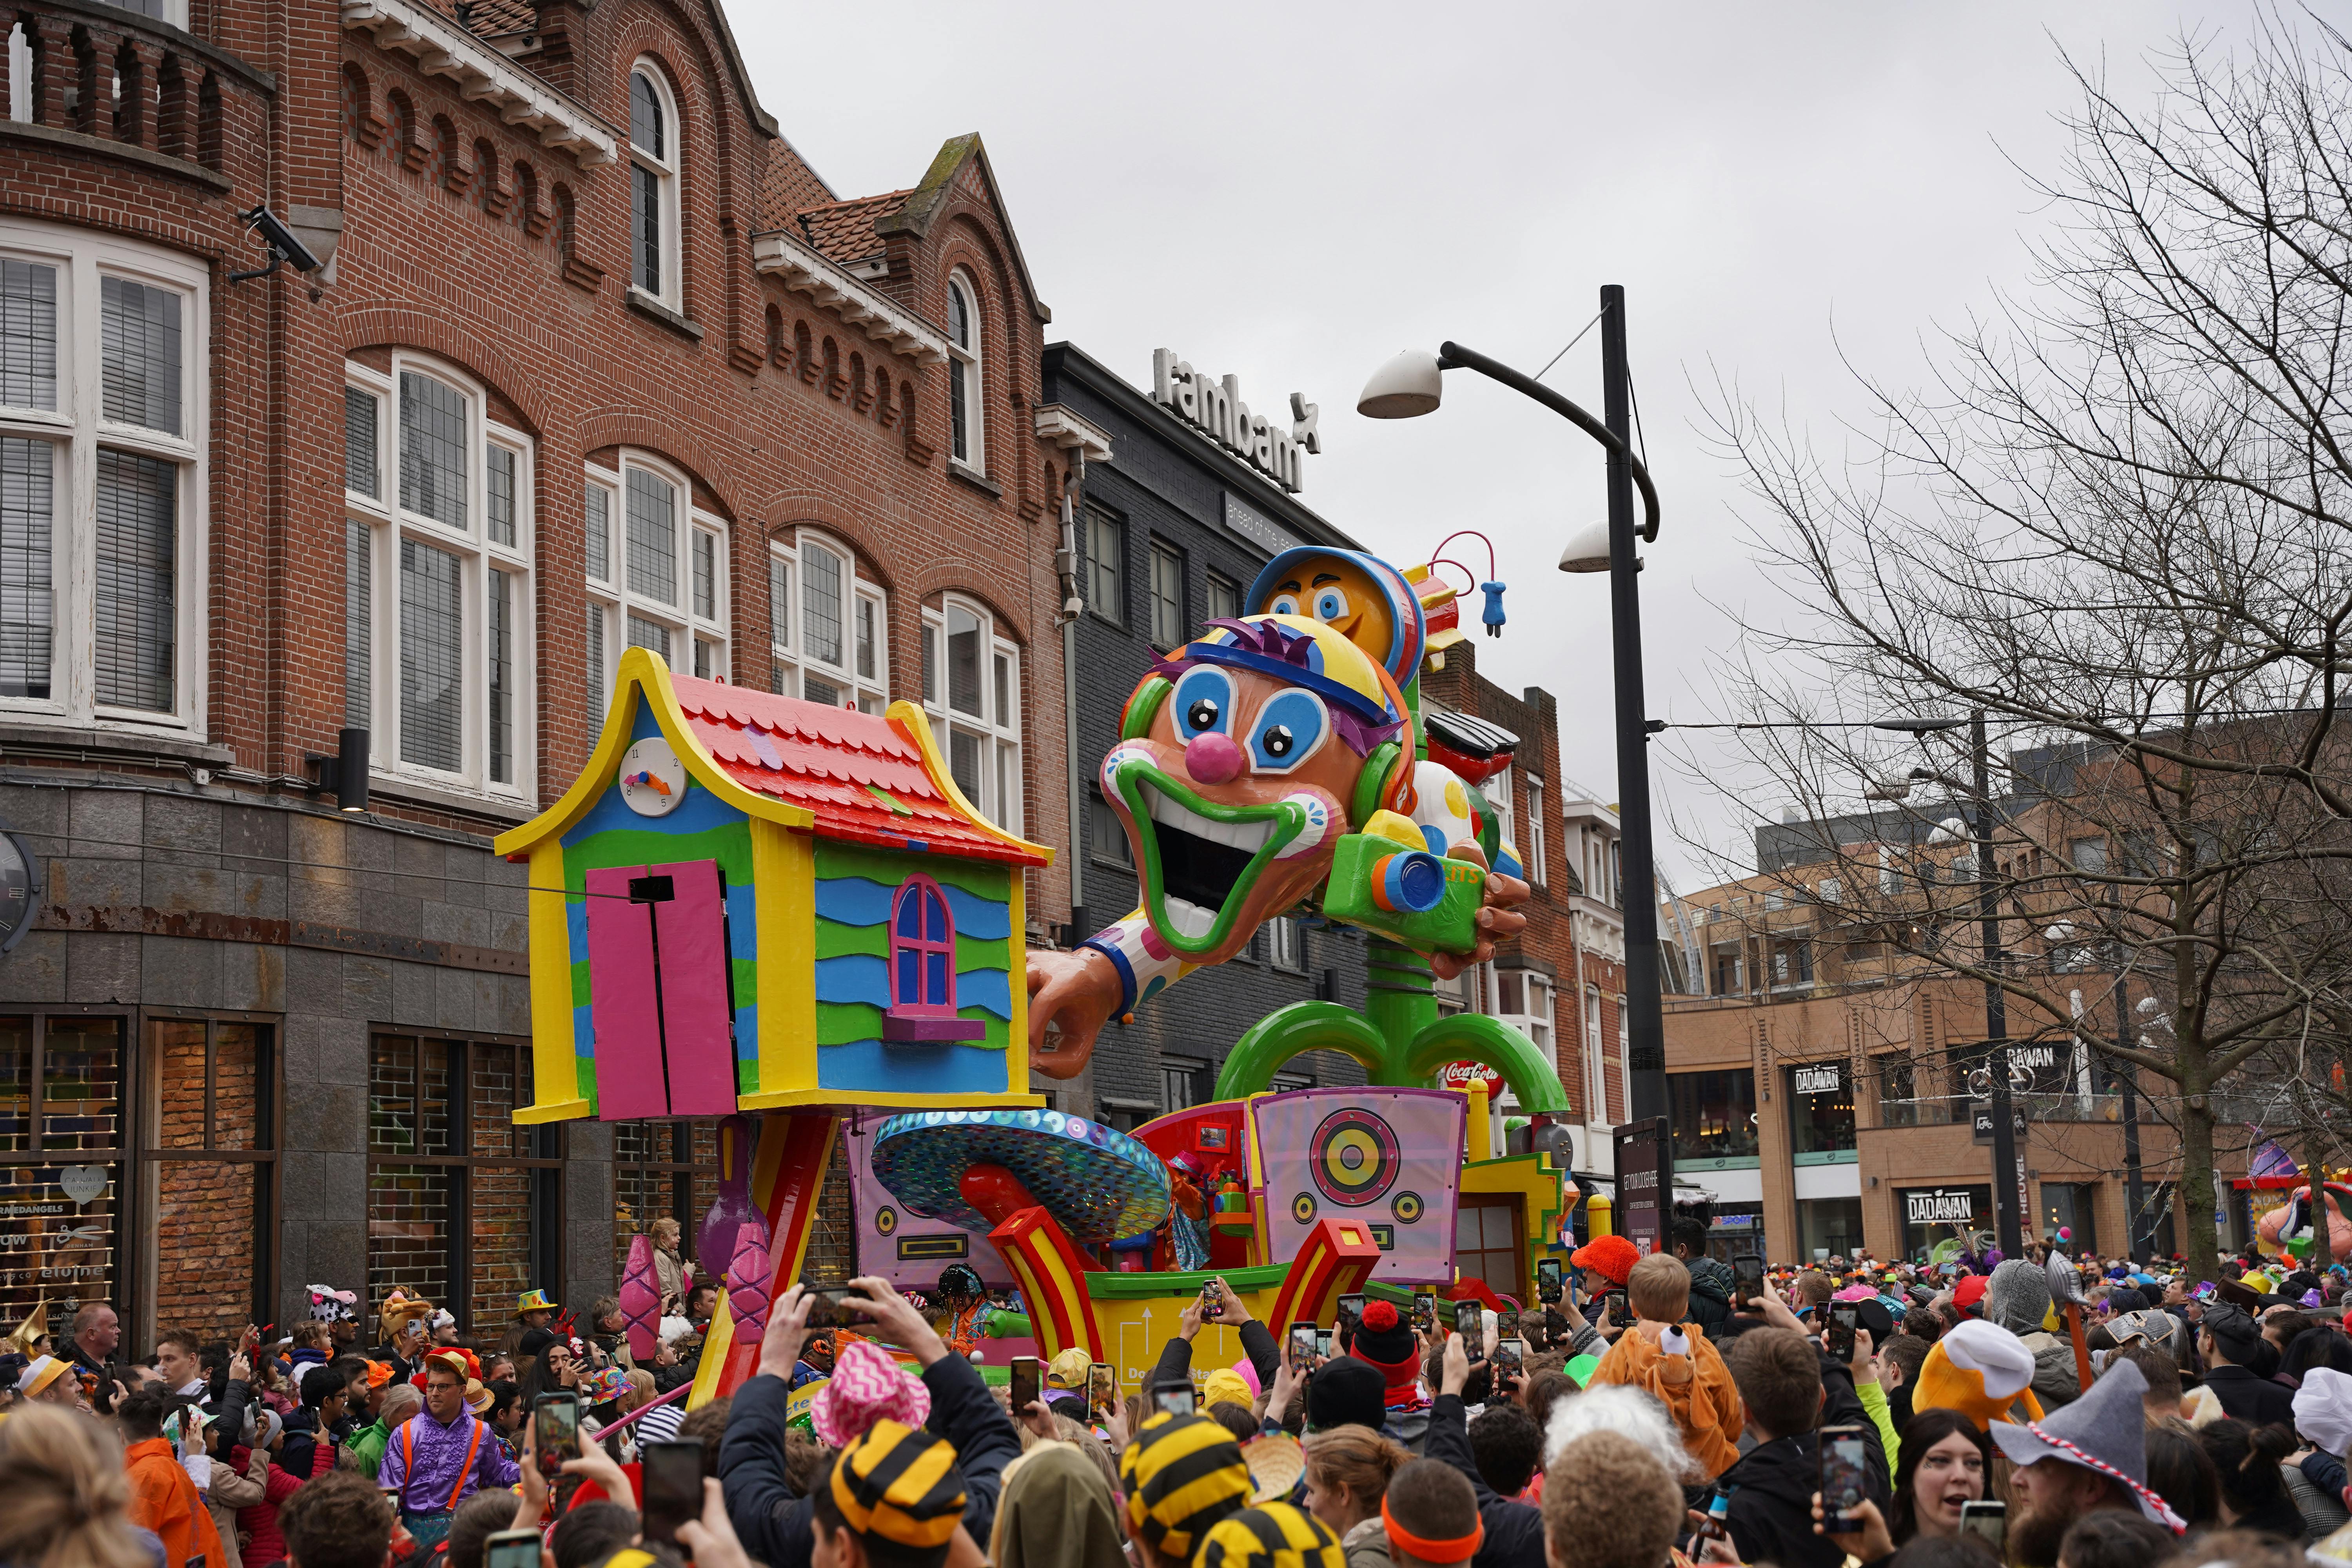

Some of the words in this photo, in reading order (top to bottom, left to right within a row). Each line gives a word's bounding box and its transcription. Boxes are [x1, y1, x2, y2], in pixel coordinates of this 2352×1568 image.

[1153, 347, 1302, 493] rambam
[1228, 501, 1253, 531] ahead
[1255, 519, 1263, 537] of
[1265, 523, 1277, 547] the
[1446, 1062, 1499, 1082] Coca-Cola
[1795, 1069, 1839, 1091] DADAWAN
[1629, 1172, 1638, 1190] YOUR
[2016, 1154, 2029, 1214] HEUVEL
[1908, 1196, 1972, 1221] DADAWAN
